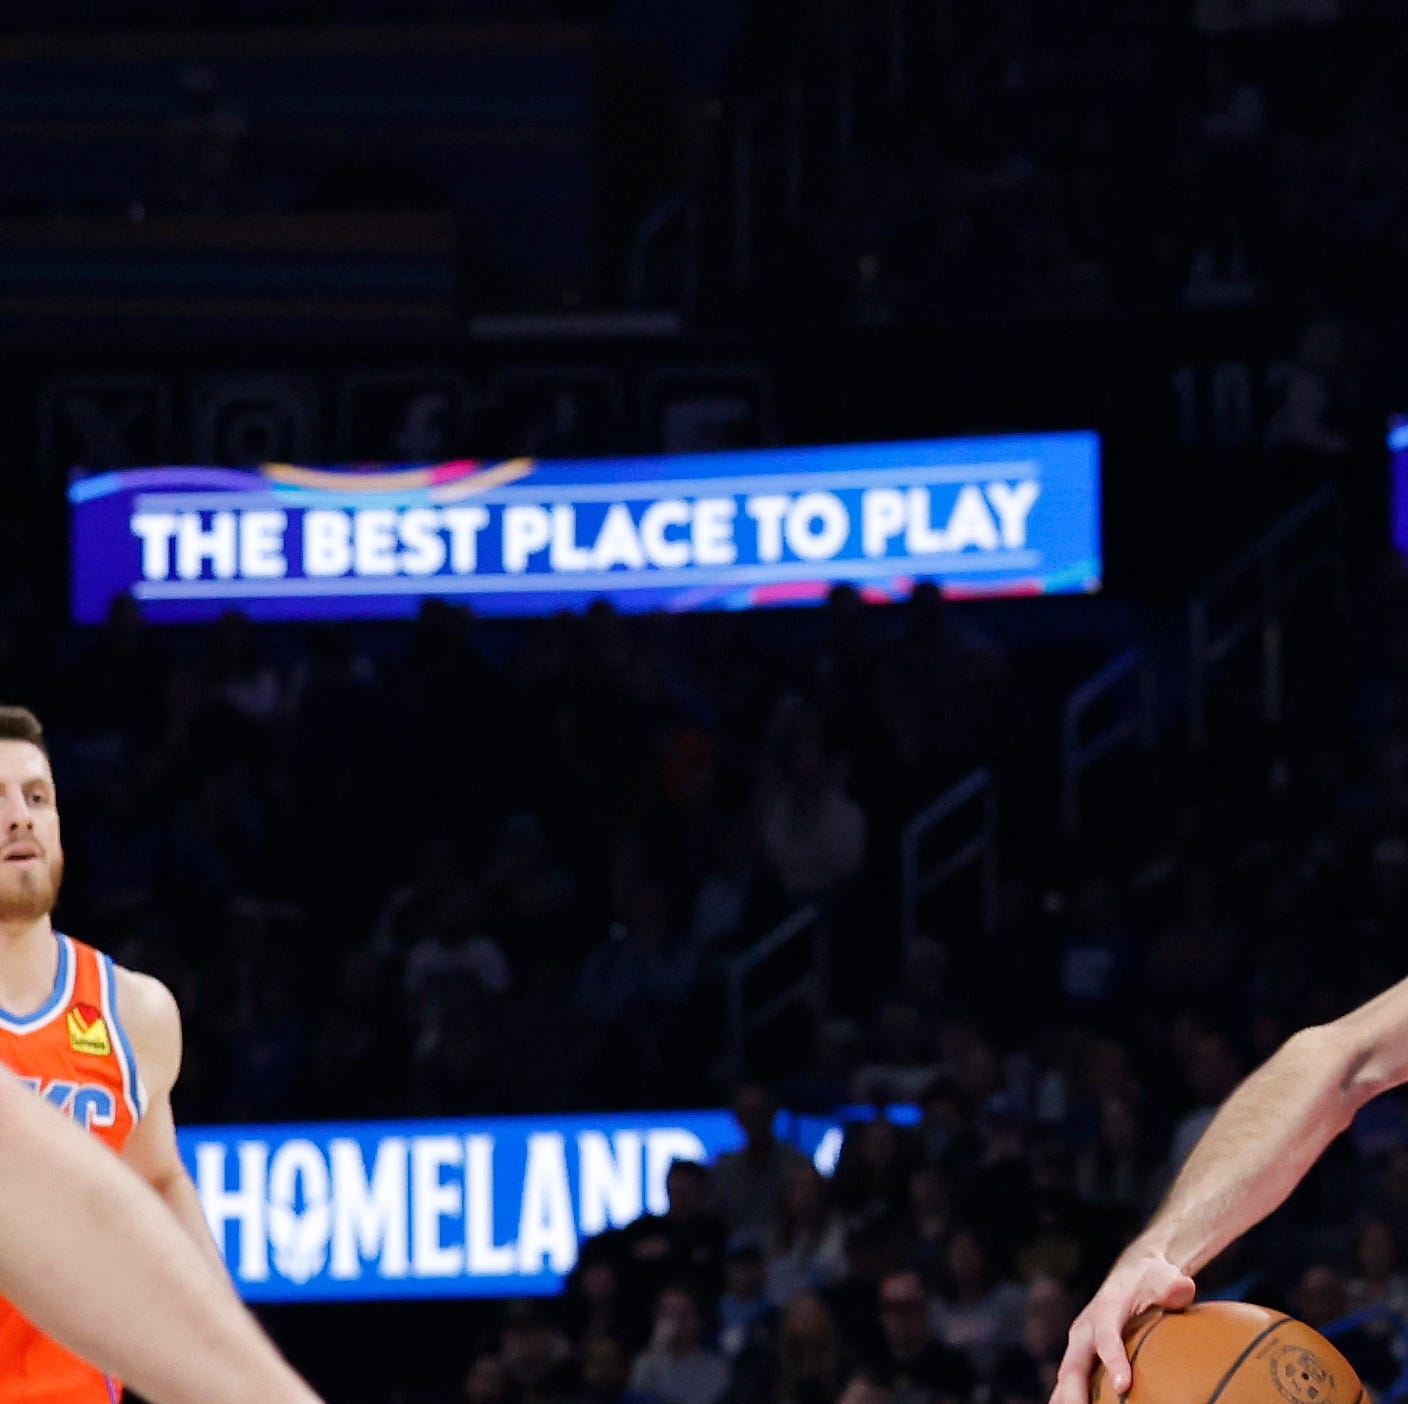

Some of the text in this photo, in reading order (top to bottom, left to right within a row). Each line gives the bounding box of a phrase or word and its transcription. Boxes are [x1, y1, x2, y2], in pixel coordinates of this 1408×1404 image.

[132, 480, 1039, 579] THE BEST PLACE TO PLAY
